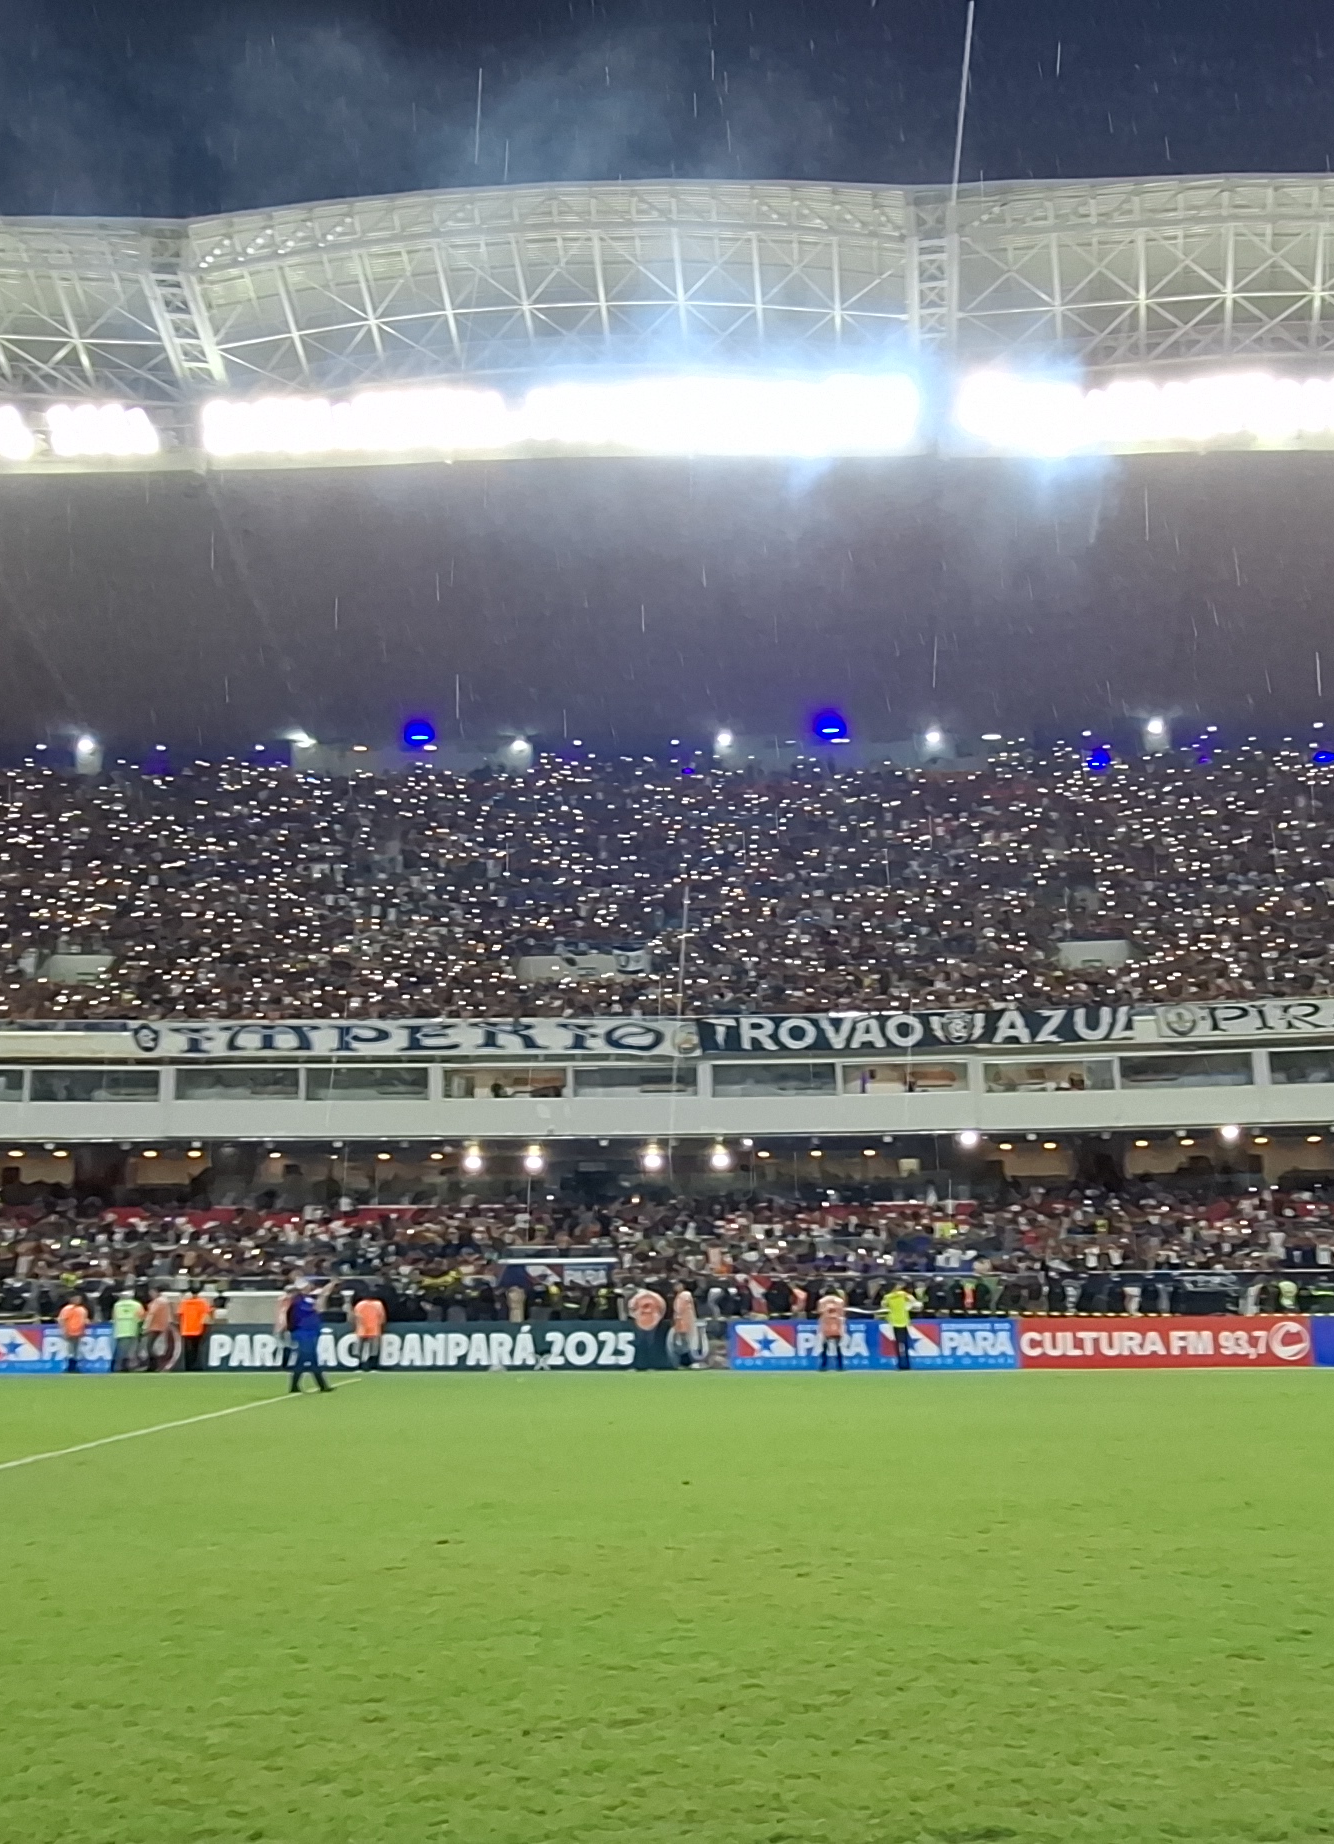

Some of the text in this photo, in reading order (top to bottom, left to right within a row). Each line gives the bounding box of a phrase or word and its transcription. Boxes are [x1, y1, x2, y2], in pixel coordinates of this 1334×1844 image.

[991, 1006, 1135, 1044] AZUL
[379, 1325, 536, 1366] BANPARÁ
[545, 1331, 636, 1366] 2025
[1020, 1330, 1268, 1360] CULTURA FM 93,7
